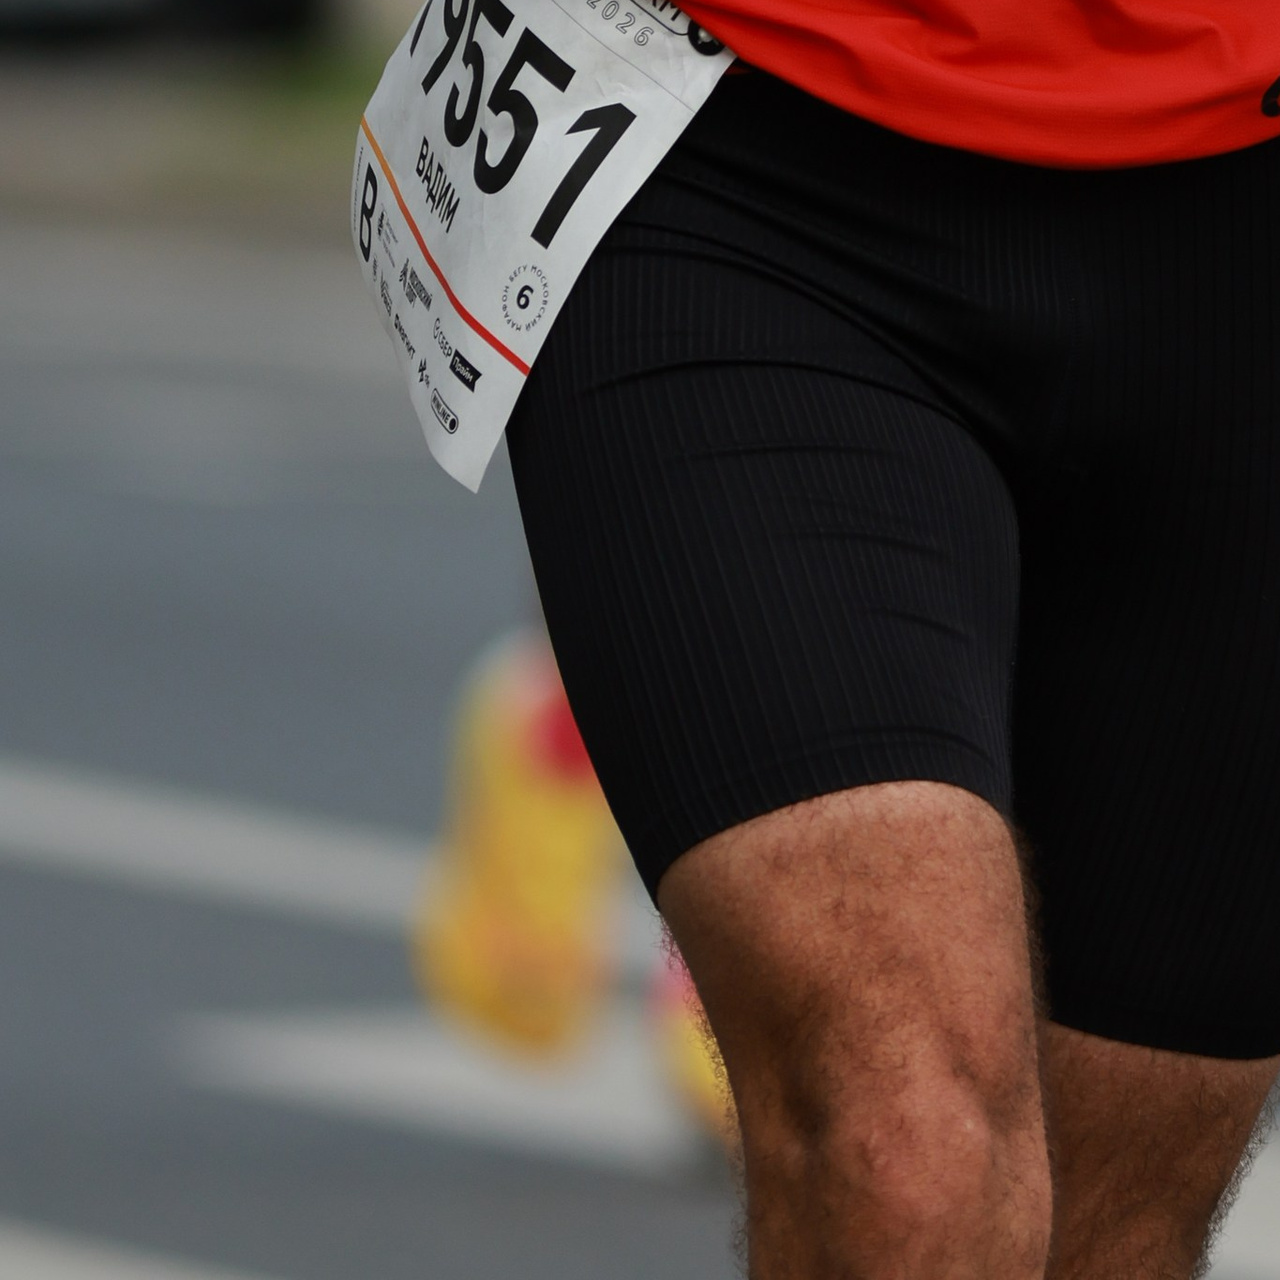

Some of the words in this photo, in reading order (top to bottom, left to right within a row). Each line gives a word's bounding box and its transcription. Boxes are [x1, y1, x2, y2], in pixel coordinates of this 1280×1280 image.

[415, 135, 461, 234] ВАДИМ
[508, 264, 528, 283] БЕГУ
[516, 284, 534, 310] 6
[525, 264, 549, 332] МОСКОВСКИЙ
[501, 285, 522, 332] МАРАФОН
[437, 330, 453, 358] СБЕР
[452, 356, 474, 383] Прайм
